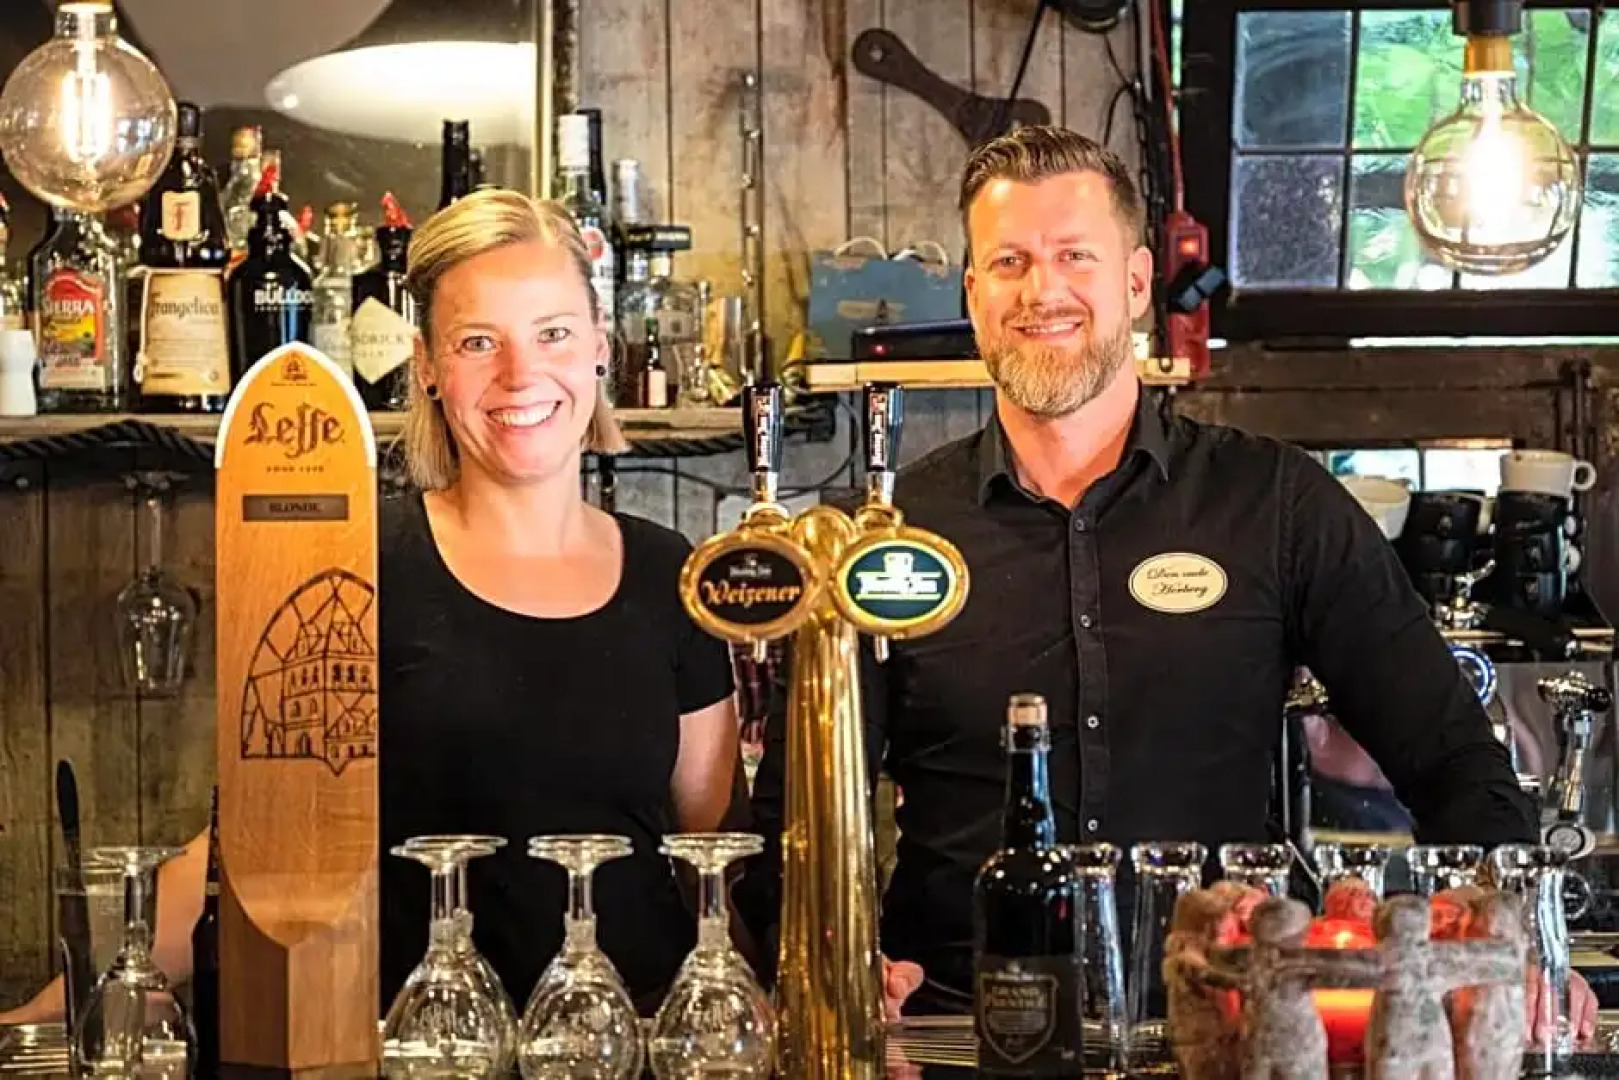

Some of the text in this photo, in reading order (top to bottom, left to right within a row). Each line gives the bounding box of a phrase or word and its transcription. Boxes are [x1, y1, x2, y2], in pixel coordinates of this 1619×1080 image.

[243, 402, 346, 459] Leffe
[268, 502, 321, 514] BLONDE
[701, 579, 800, 608] Weizener
